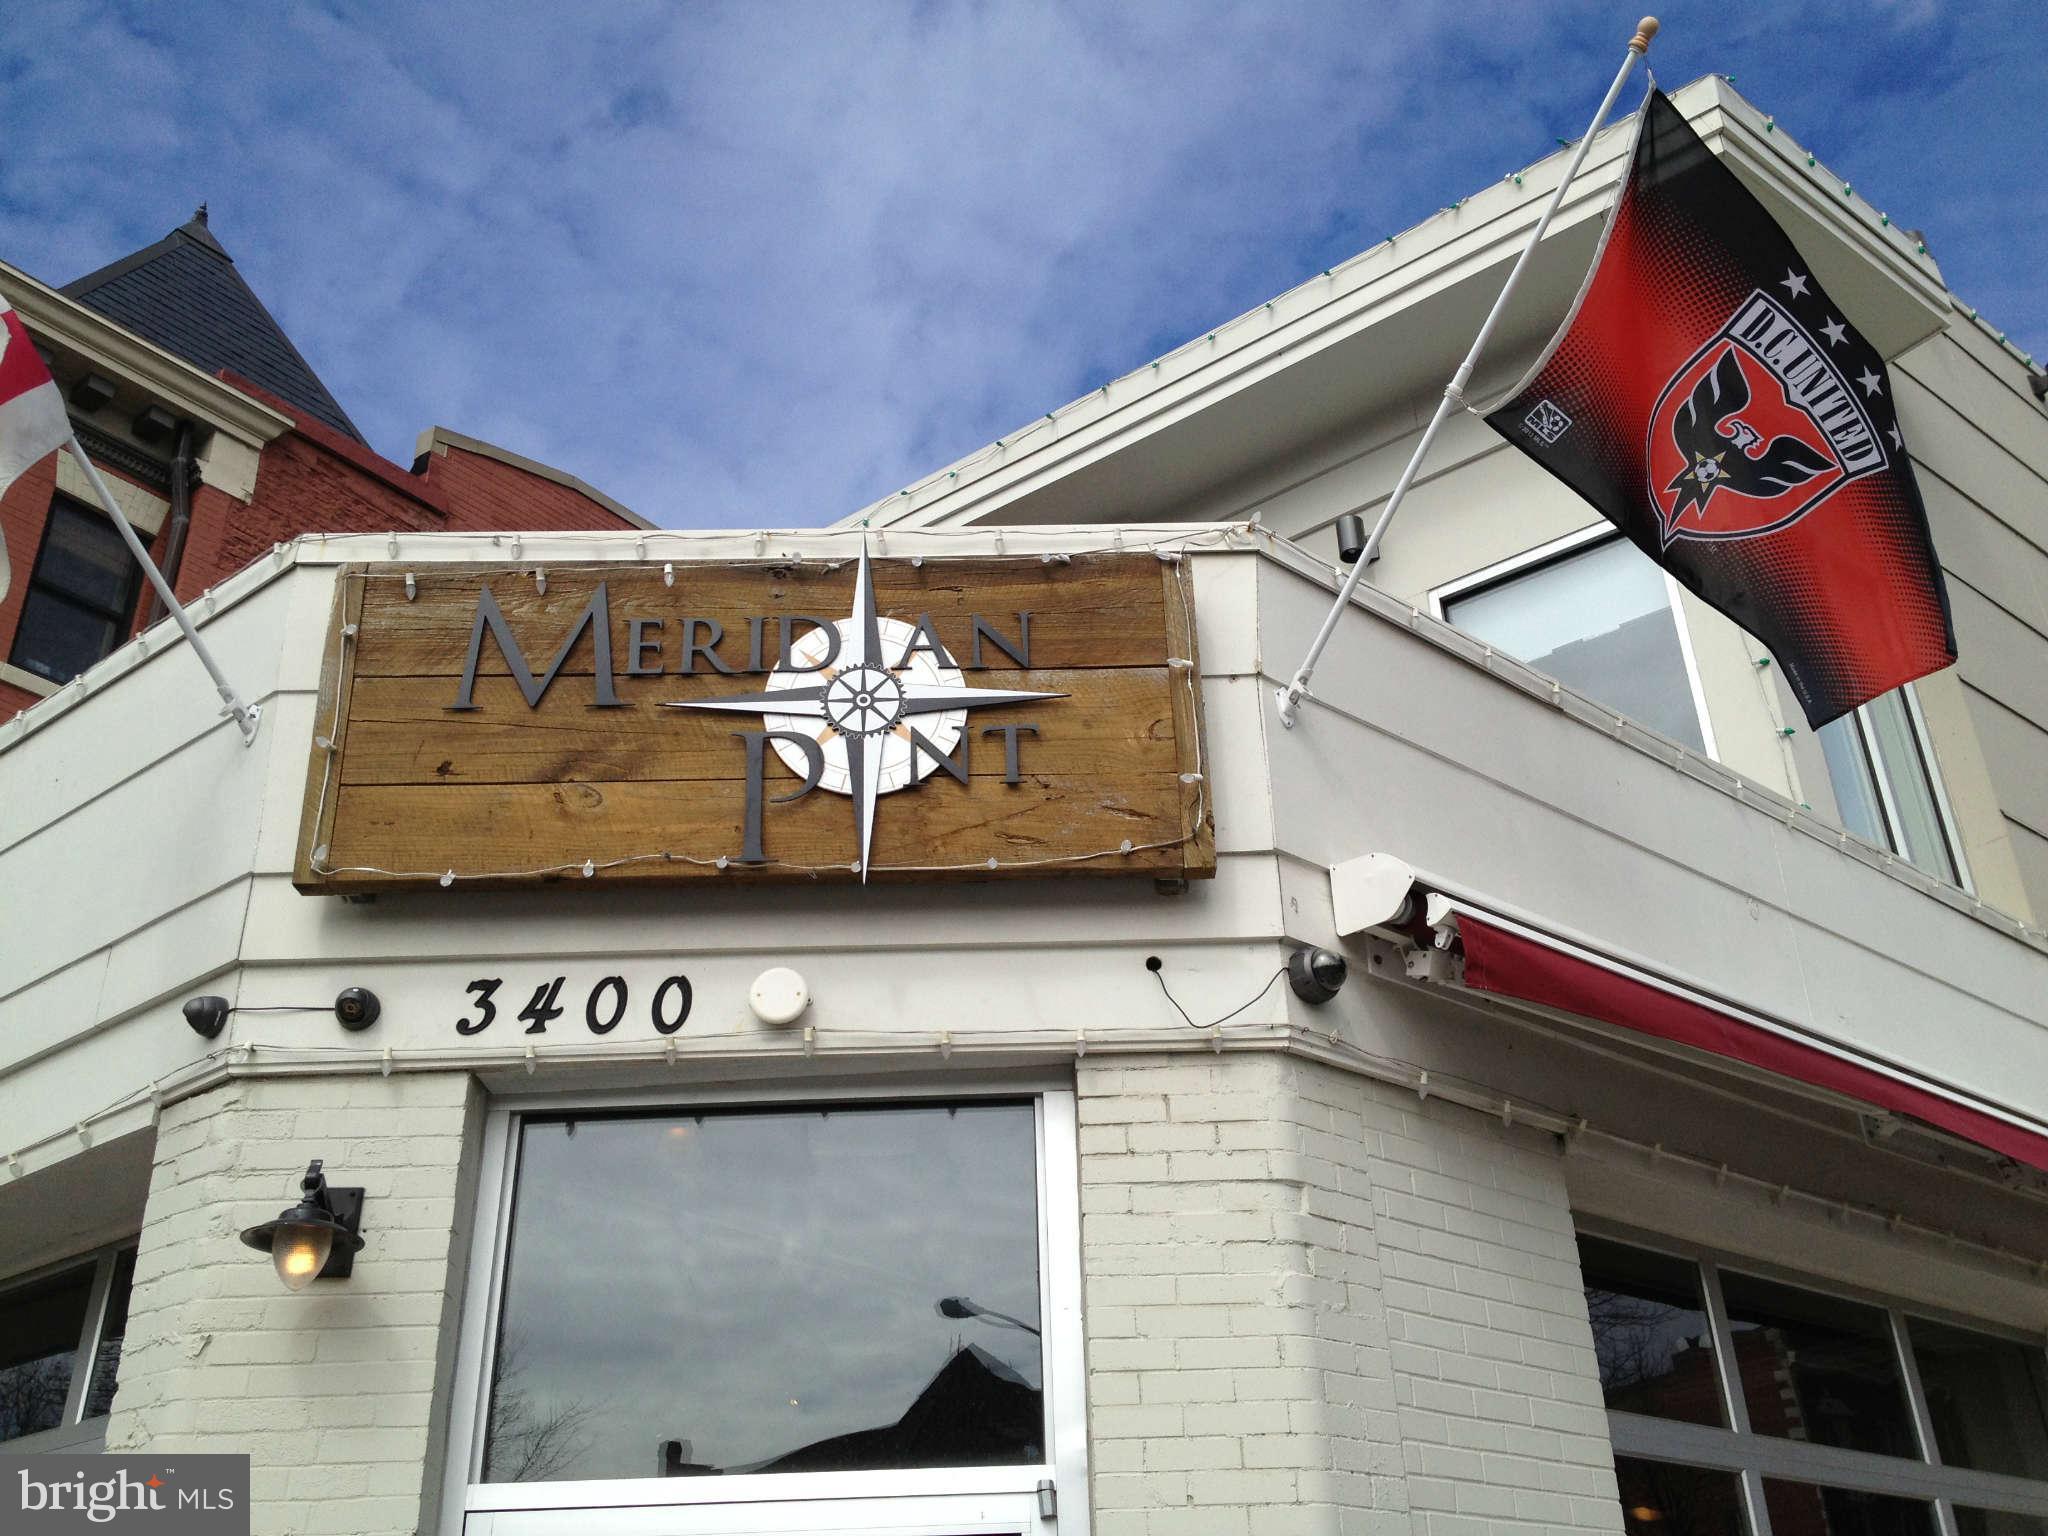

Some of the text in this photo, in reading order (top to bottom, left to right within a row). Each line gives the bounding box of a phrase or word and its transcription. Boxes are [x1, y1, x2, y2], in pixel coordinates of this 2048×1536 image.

[1739, 304, 1875, 462] D.C. UNITED
[456, 975, 693, 1036] 3400
